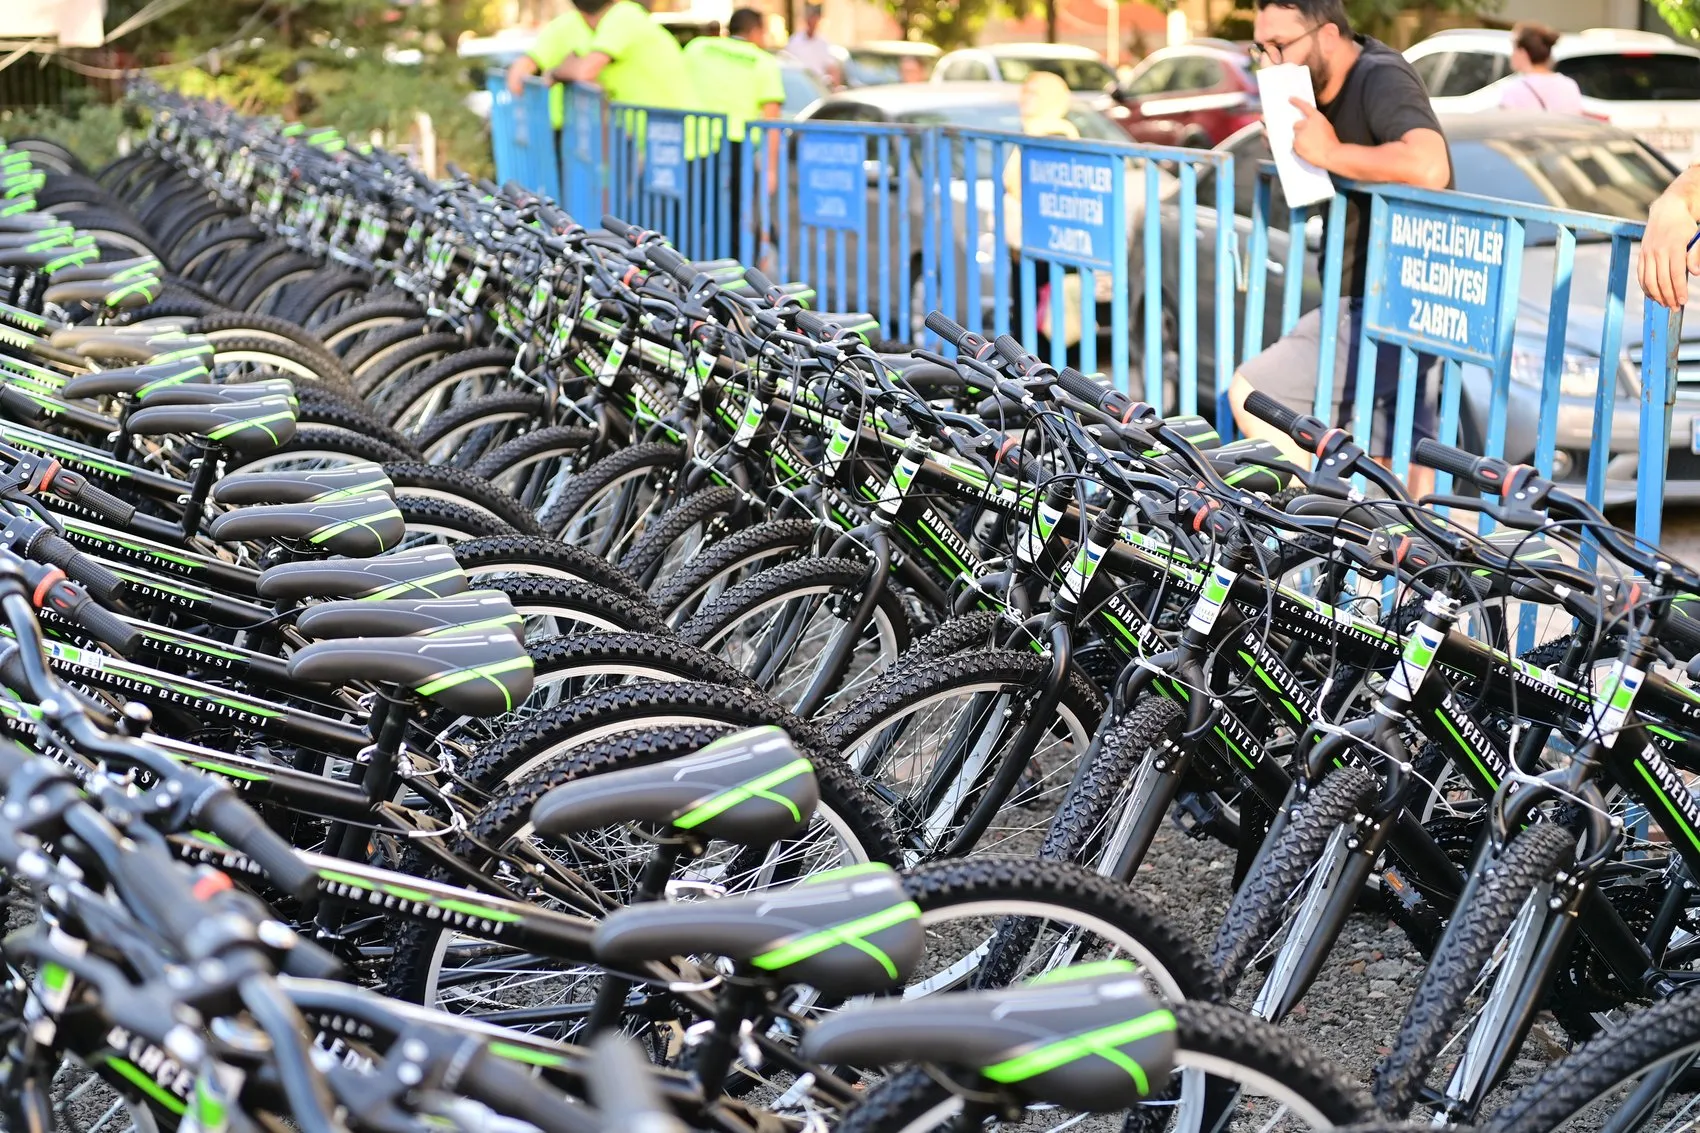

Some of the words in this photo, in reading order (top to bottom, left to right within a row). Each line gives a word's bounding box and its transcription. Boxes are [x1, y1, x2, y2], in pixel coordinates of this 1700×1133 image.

[1391, 213, 1504, 266] BAHÇELİEVLER
[1401, 256, 1488, 306] BELEDİYESİ
[1408, 298, 1468, 344] ZABITA
[921, 508, 991, 578] BAHÇELİEVE
[123, 580, 195, 609] EDİYESİ
[1279, 600, 1302, 616] T.C.
[1304, 609, 1393, 652] BAHÇELİEVLER
[142, 637, 232, 669] ELEDİYESİ
[1243, 632, 1320, 722] BAHÇELİEVLE
[158, 689, 268, 727] BELEDİYESİ
